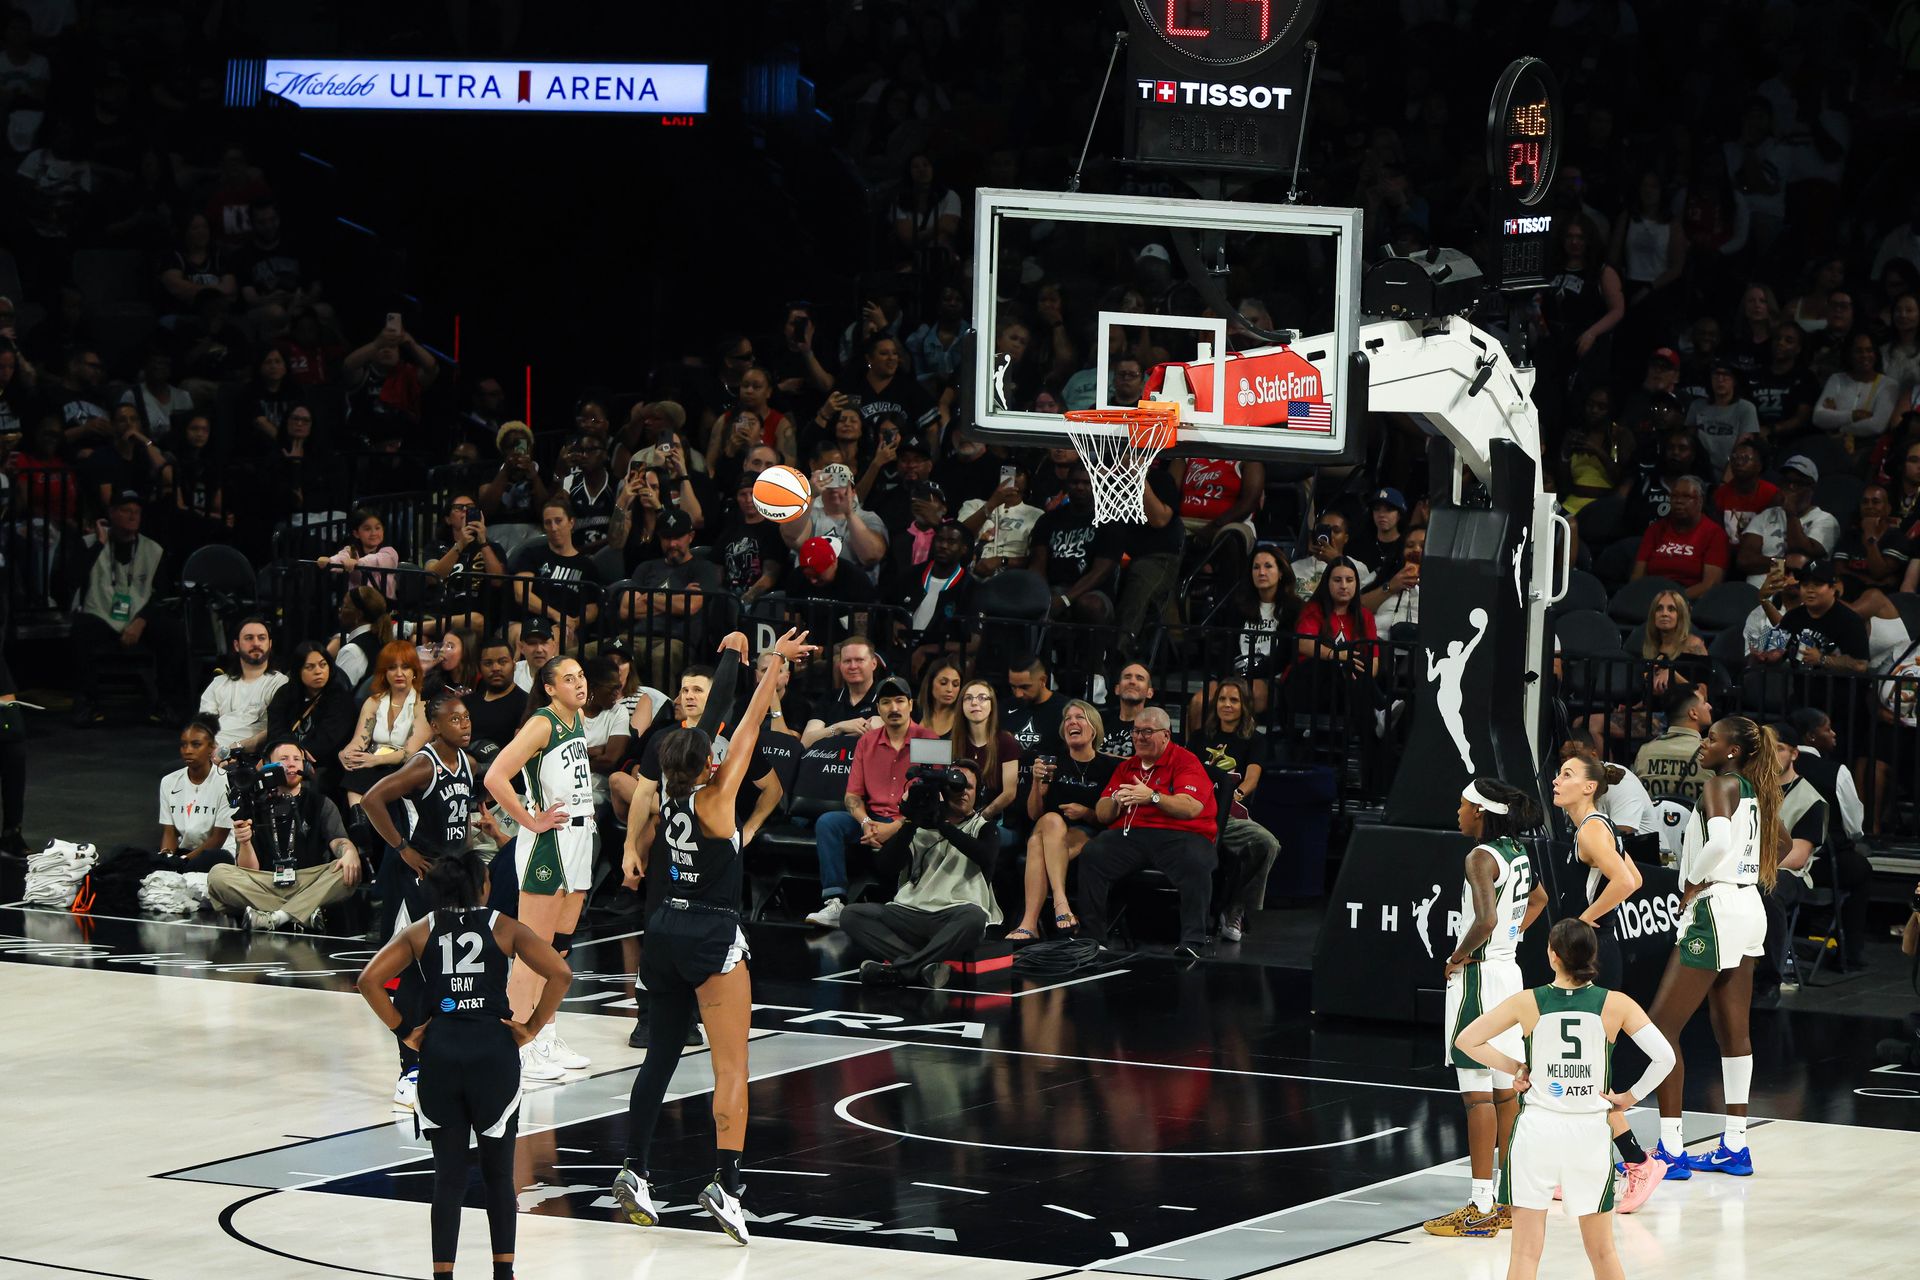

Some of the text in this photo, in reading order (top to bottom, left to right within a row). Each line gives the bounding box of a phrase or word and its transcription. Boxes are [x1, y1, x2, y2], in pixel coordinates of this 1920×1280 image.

[265, 71, 660, 101] Michelob ULTRA ARENA
[1180, 82, 1291, 110] TISSOT
[1508, 143, 1539, 185] 24
[1517, 216, 1551, 233] TISSOT
[1185, 465, 1222, 489] Vegas
[1204, 484, 1224, 499] 22
[1014, 734, 1040, 742] ACES
[762, 746, 791, 758] ULTRA
[800, 748, 838, 760] Michelob
[822, 764, 852, 774] AREN
[1648, 758, 1698, 776] METRO
[574, 764, 589, 789] 54
[440, 784, 455, 801] LAS
[448, 799, 467, 823] 24
[680, 872, 700, 883] AT&T
[439, 931, 485, 974] 12
[451, 977, 473, 992] GRAY
[457, 998, 485, 1010] AT&T
[1561, 1018, 1582, 1060] 5
[1566, 1085, 1594, 1097] AT&T
